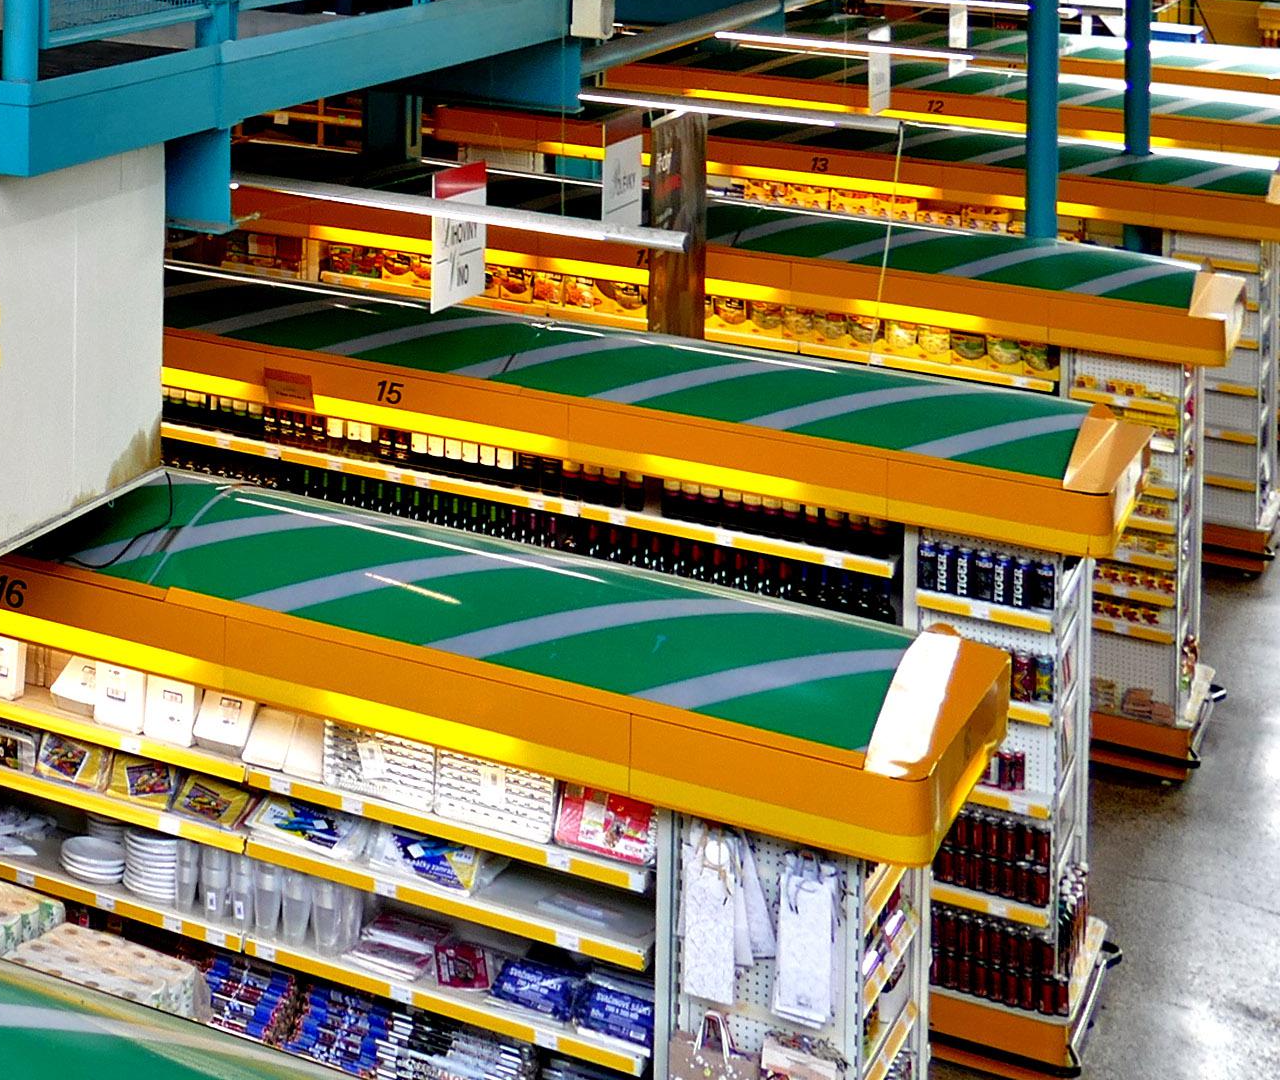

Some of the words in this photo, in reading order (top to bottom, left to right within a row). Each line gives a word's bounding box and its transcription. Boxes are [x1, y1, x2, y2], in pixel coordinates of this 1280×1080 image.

[926, 99, 945, 114] 12
[810, 156, 830, 173] 13
[635, 248, 650, 266] 1
[376, 379, 405, 405] 15
[937, 553, 948, 592] TIGER
[957, 557, 968, 596] TIGER
[993, 564, 1005, 603] TIGER
[1013, 568, 1024, 606] TIGER
